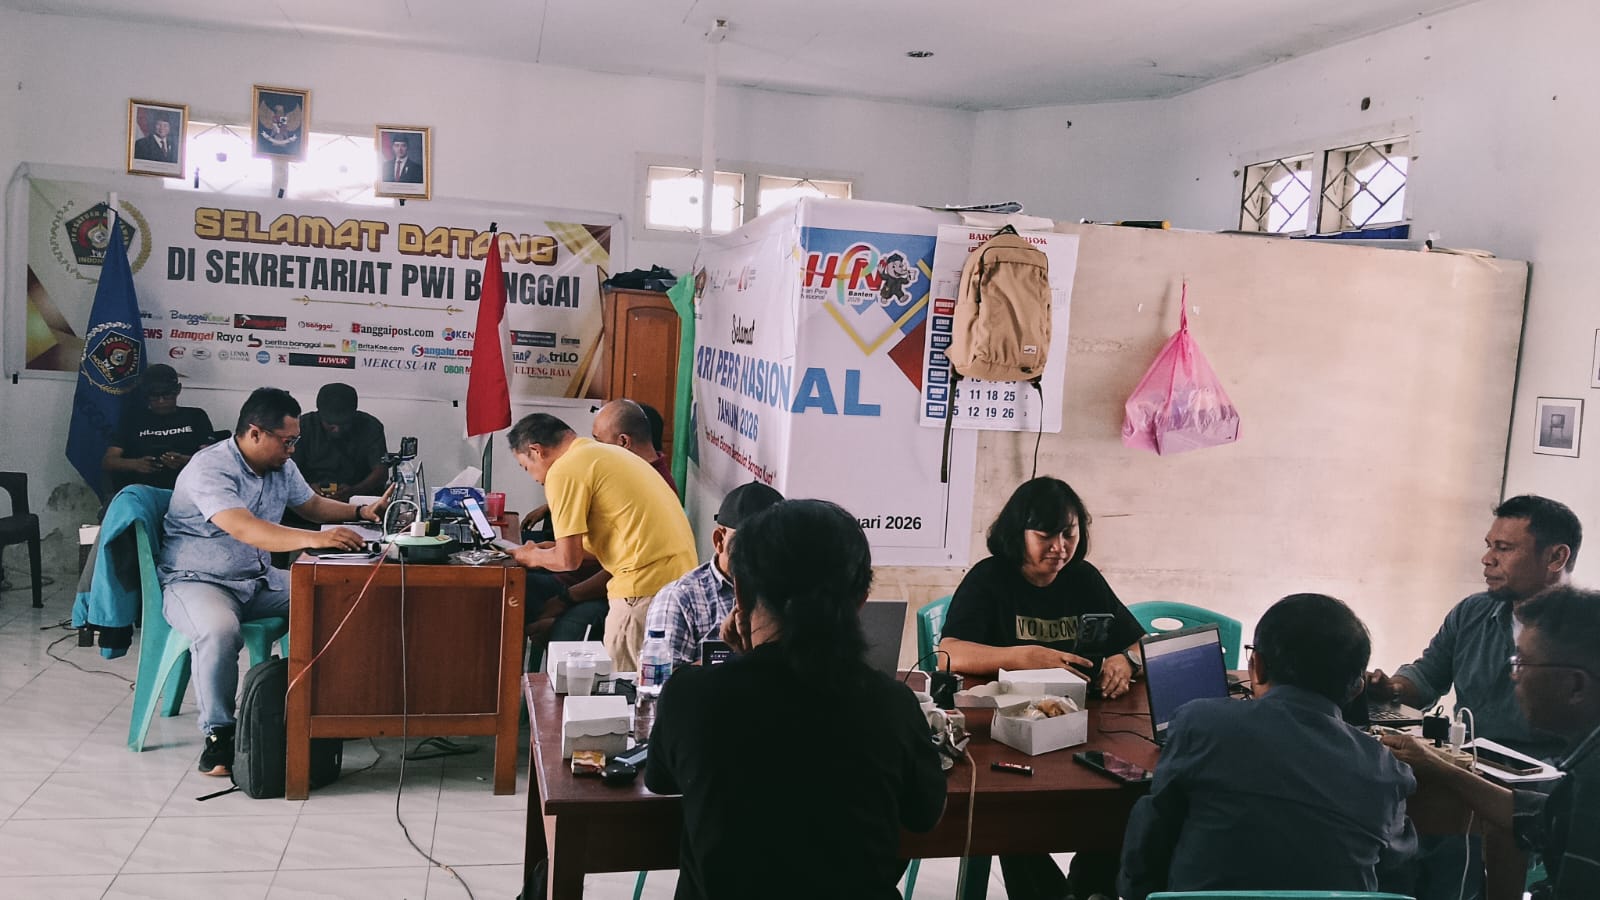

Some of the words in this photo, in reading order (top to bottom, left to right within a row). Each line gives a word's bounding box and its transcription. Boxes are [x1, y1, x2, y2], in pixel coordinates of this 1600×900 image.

[195, 207, 389, 252] SELAMAT
[398, 223, 558, 266] DATANG
[168, 246, 195, 281] DI
[206, 249, 392, 295] SEKRETARIAT
[402, 264, 454, 299] PWI
[465, 268, 580, 308] BNGGAI
[142, 328, 163, 339] EWS
[170, 329, 214, 341] Banggai
[216, 332, 243, 343] Raya
[352, 322, 434, 337] Banggaipost.com
[455, 331, 474, 339] KEN
[361, 358, 437, 371] MERCUSUAR
[514, 366, 548, 376] ULTENG
[550, 368, 572, 377] RAYA
[697, 345, 716, 381] ARI
[715, 350, 741, 392] PERS
[970, 389, 981, 399] 11
[986, 390, 998, 401] 18
[1004, 391, 1015, 402] 25
[717, 397, 739, 432] TAHUN
[739, 407, 759, 442] 2026
[968, 406, 980, 417] 12
[986, 407, 997, 418] 19
[1002, 408, 1014, 419] 26
[857, 515, 881, 529] ari
[885, 516, 922, 530] 2026
[1018, 618, 1077, 639] VOLCOM
